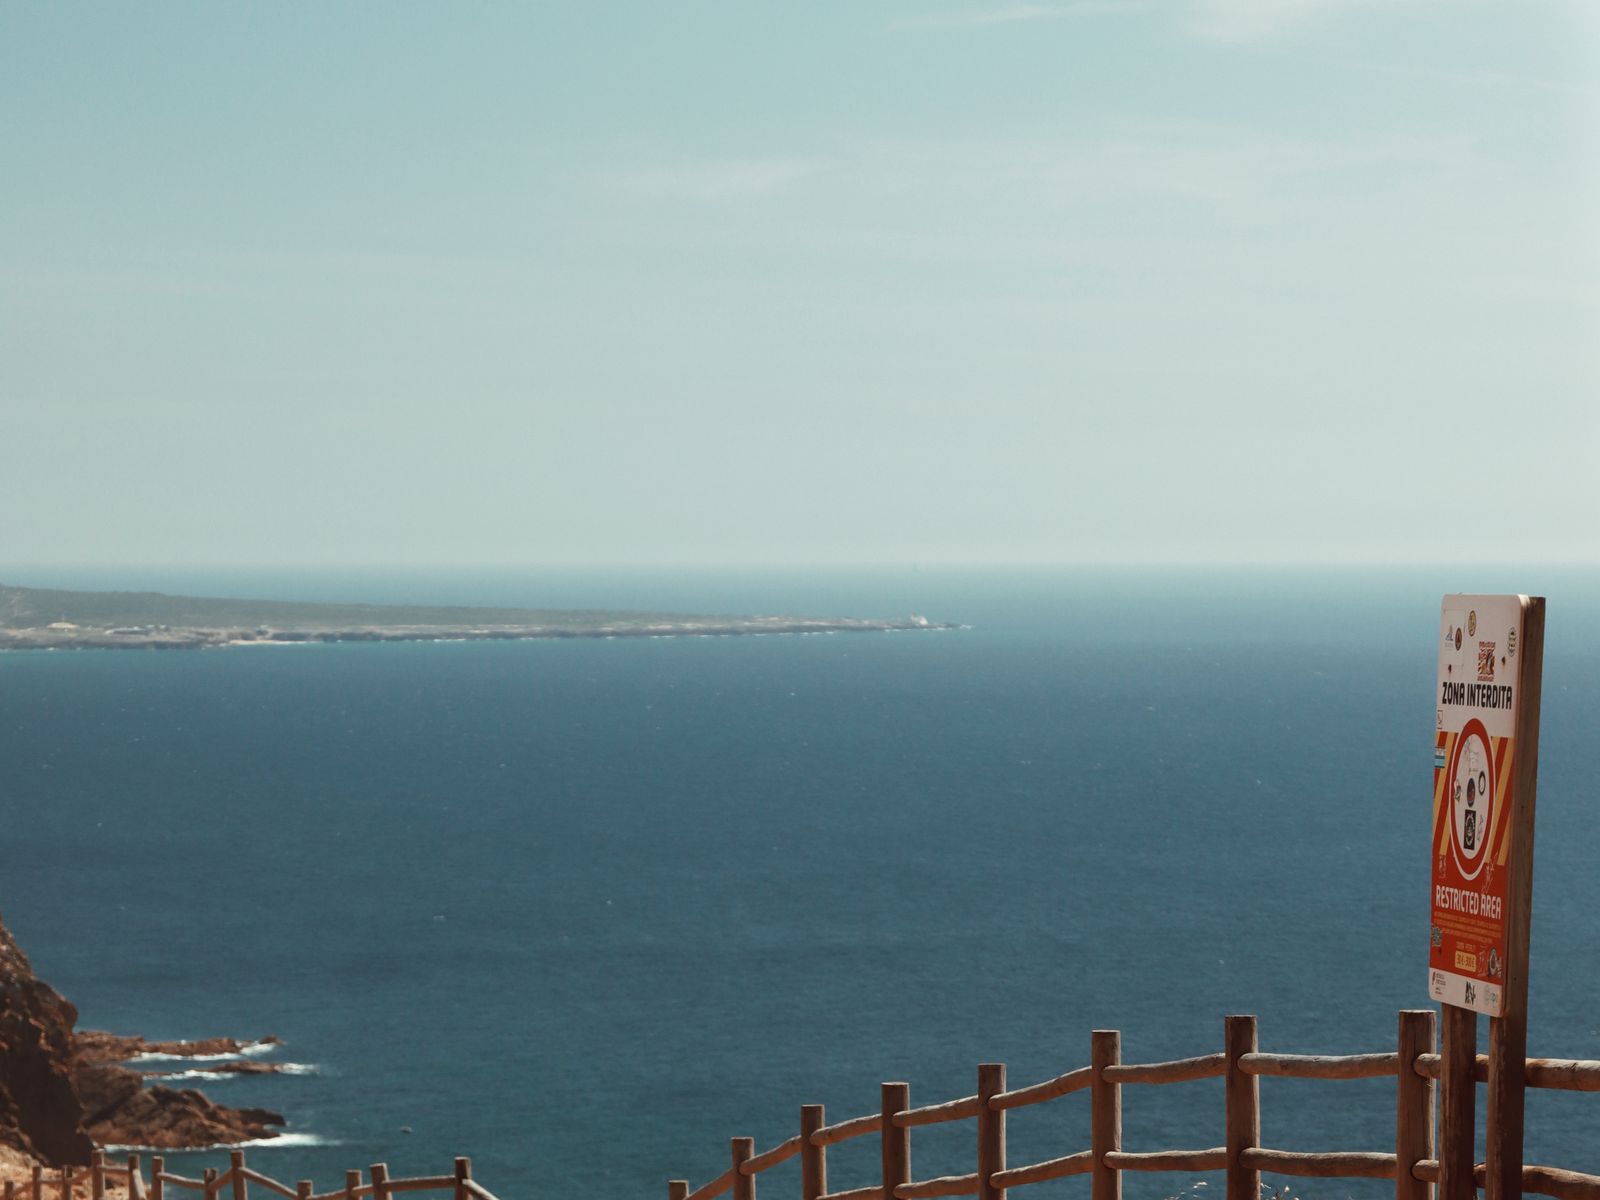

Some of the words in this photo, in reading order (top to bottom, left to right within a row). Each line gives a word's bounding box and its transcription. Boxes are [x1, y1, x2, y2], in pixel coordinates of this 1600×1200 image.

[1442, 682, 1465, 705] ZONA
[1467, 684, 1512, 709] INTERDITA
[1436, 885, 1479, 914] RESTRICTED
[1480, 894, 1501, 919] AREA
